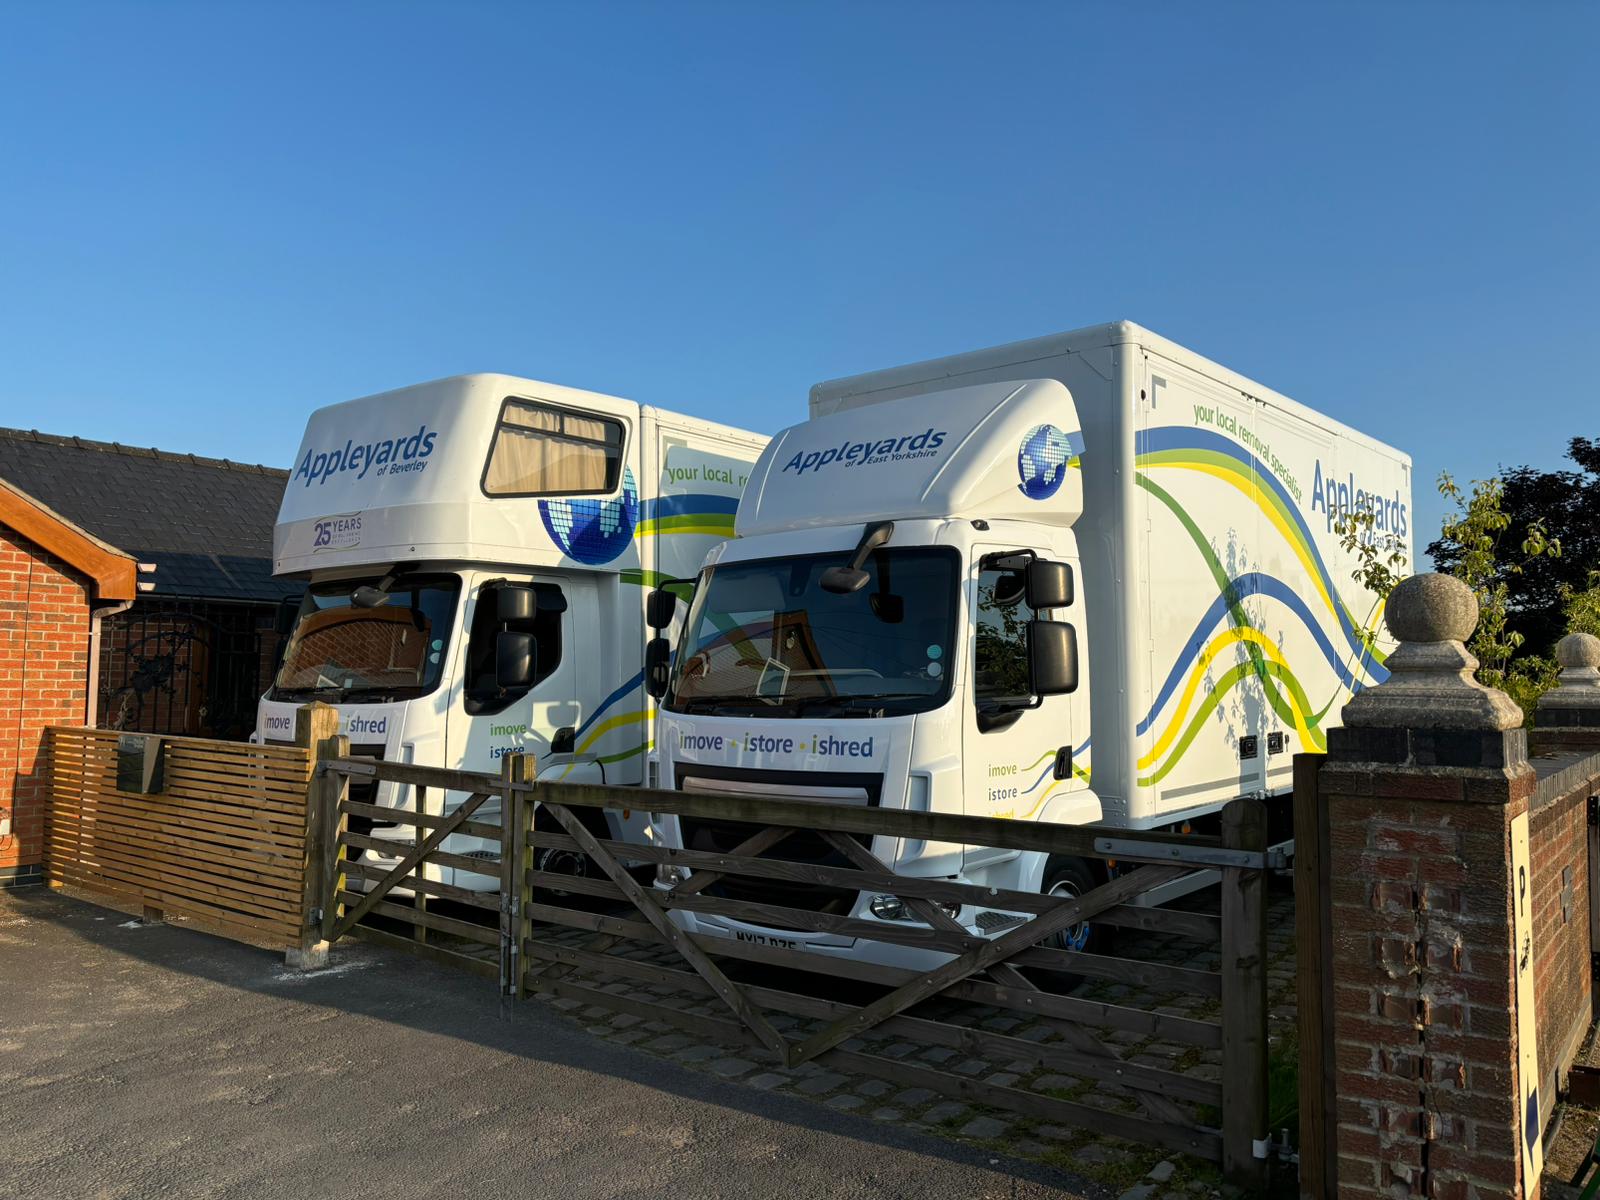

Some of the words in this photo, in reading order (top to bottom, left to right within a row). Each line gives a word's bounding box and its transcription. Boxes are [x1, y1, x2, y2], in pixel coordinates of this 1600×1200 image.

[1193, 404, 1214, 425] your
[1216, 406, 1237, 436] local
[1239, 425, 1270, 463] removal
[294, 425, 438, 487] Appleyards
[782, 428, 947, 475] Appleyards
[845, 459, 857, 468] of
[867, 455, 888, 465] East
[891, 449, 938, 462] Yorkshire
[377, 464, 390, 476] of
[389, 460, 428, 475] Beverley
[668, 467, 698, 484] your
[702, 464, 733, 485] local
[313, 521, 331, 547] 25
[332, 517, 362, 533] YEARS
[264, 713, 291, 730] imove
[347, 714, 387, 734] ishred
[490, 723, 527, 736] imove
[679, 731, 723, 750] imove
[743, 732, 794, 753] istore
[812, 734, 874, 758] ishred
[988, 764, 1017, 777] imove
[988, 788, 1018, 801] istore
